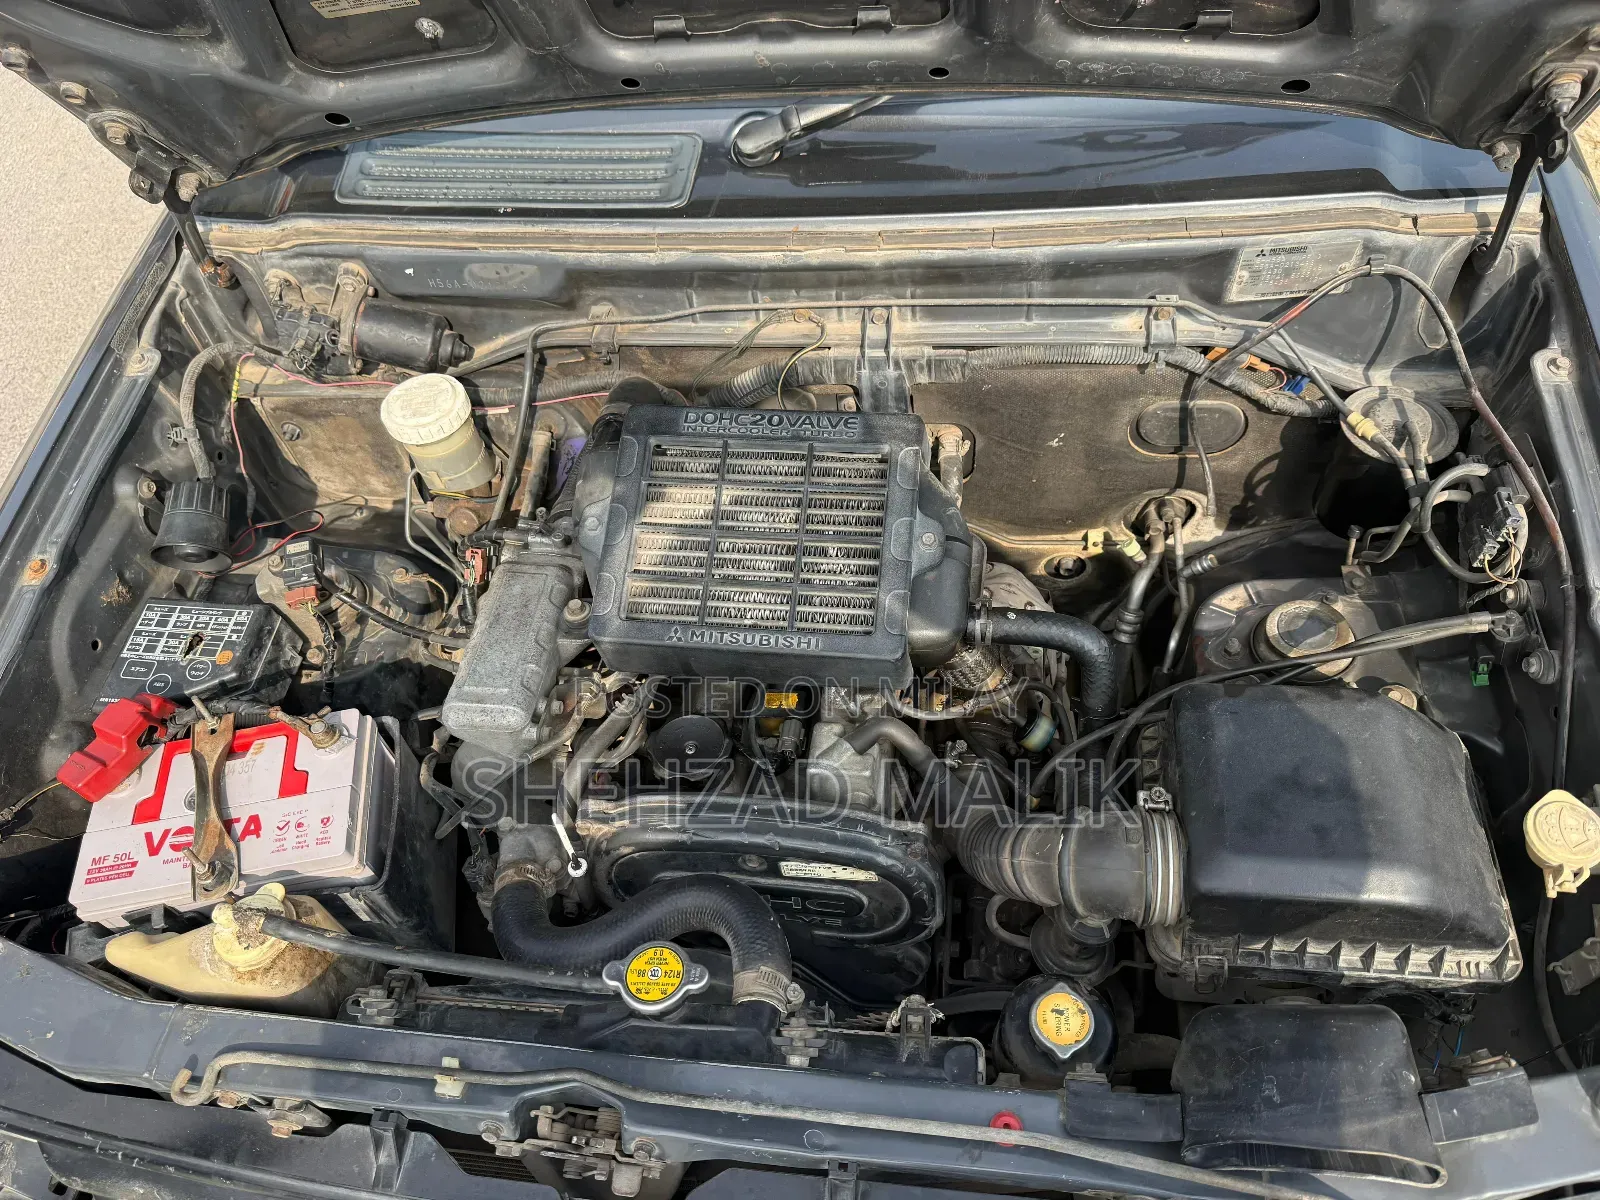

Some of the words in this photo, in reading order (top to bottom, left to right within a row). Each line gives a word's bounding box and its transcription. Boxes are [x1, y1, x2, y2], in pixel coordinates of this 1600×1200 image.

[682, 425, 791, 436] INTERCOOLER
[802, 430, 857, 438] TURBO
[689, 629, 821, 651] MITSUBISHI
[91, 854, 110, 866] MF
[113, 851, 135, 863] 50L
[664, 969, 681, 979] R124
